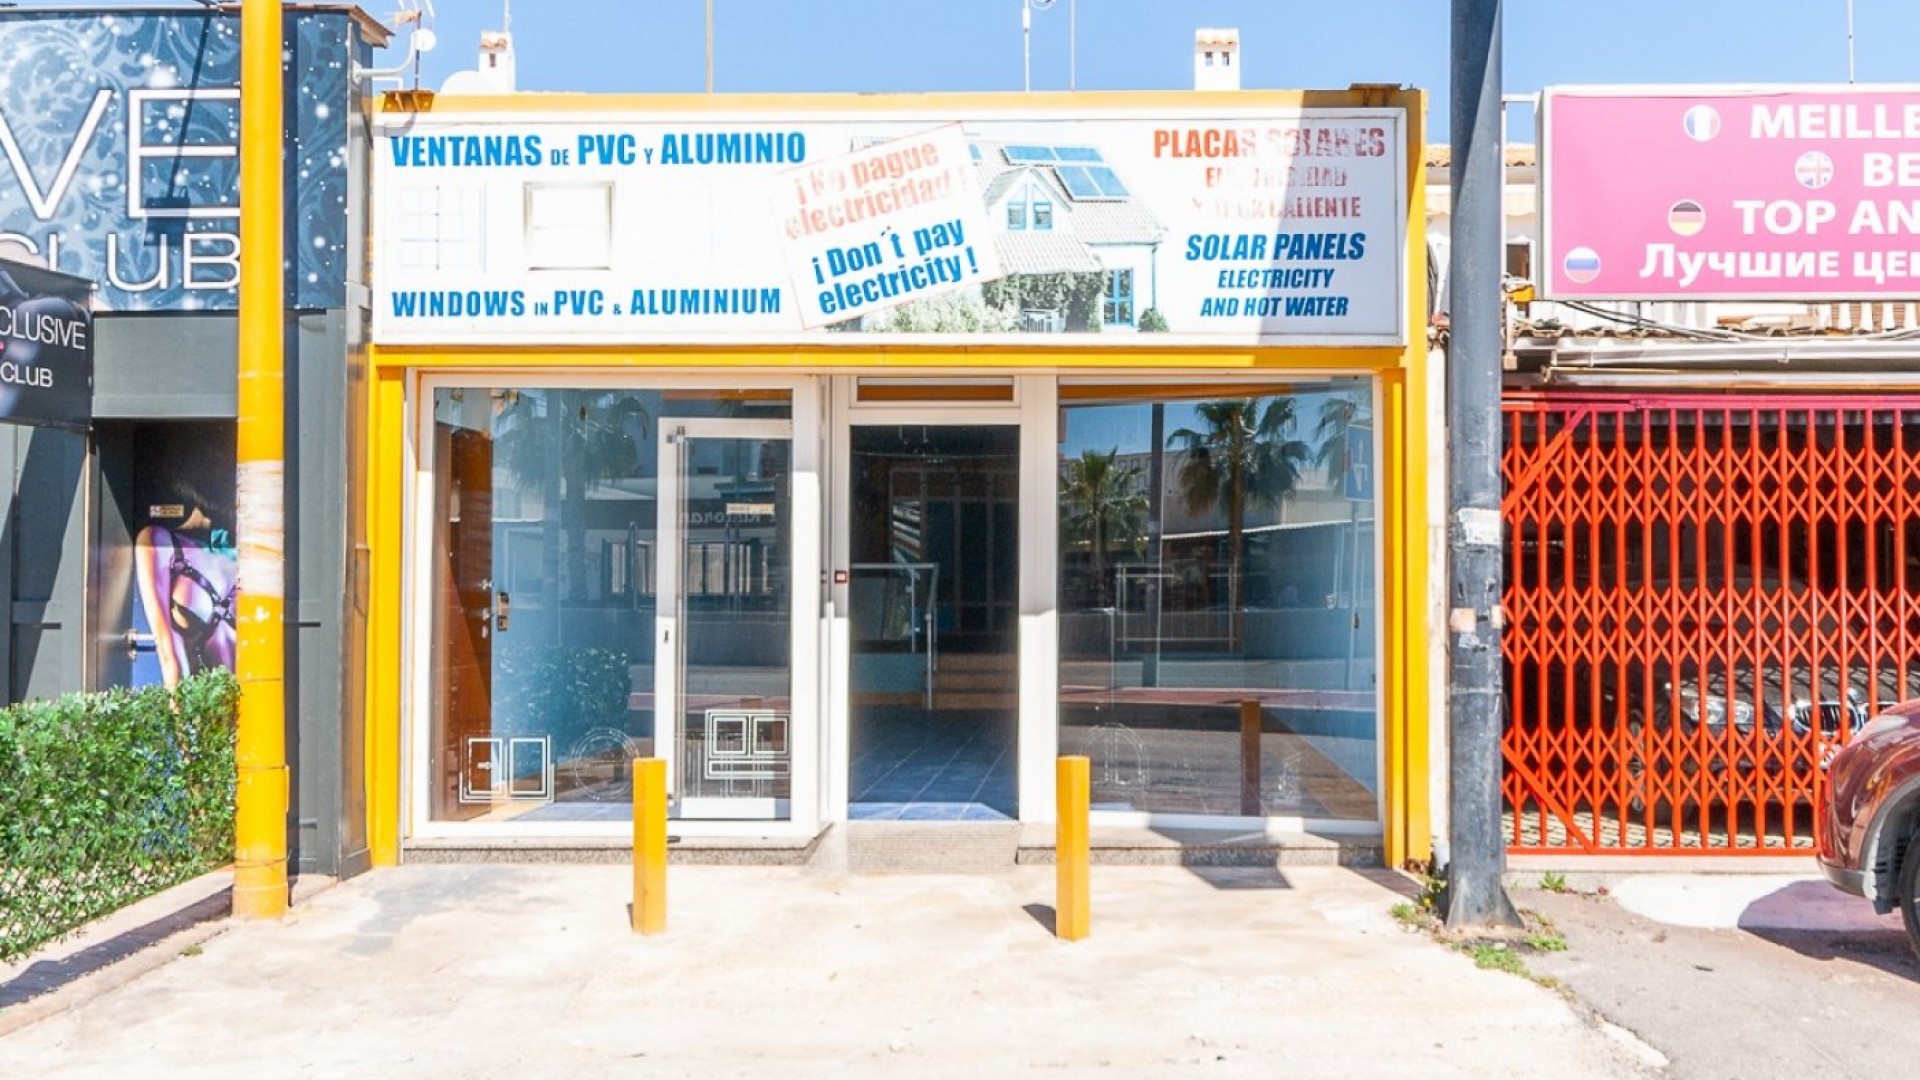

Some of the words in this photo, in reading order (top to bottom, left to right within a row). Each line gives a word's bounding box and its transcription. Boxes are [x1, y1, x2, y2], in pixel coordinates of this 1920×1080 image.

[391, 135, 542, 167] VENTANAS
[550, 148, 569, 166] DE
[578, 133, 636, 166] PVC
[643, 148, 654, 165] Y
[661, 132, 806, 165] ALUMINIO
[1862, 152, 1920, 187] BE
[1733, 200, 1837, 235] TOP
[1848, 200, 1920, 235] AN
[912, 218, 965, 254] pay
[1185, 233, 1267, 261] SOLAR
[1273, 232, 1366, 261] PANELS
[818, 254, 962, 315] electricity
[1217, 268, 1335, 289] ELECTRICITY
[392, 290, 526, 317] WINDOWS
[534, 302, 548, 316] IN
[554, 289, 604, 316] PVC
[613, 302, 622, 316] &
[630, 288, 780, 315] ALUMINIUM
[1200, 297, 1239, 317] AND
[1243, 297, 1282, 317] HOT
[1286, 296, 1349, 317] WATER
[0, 361, 53, 388] CLUB
